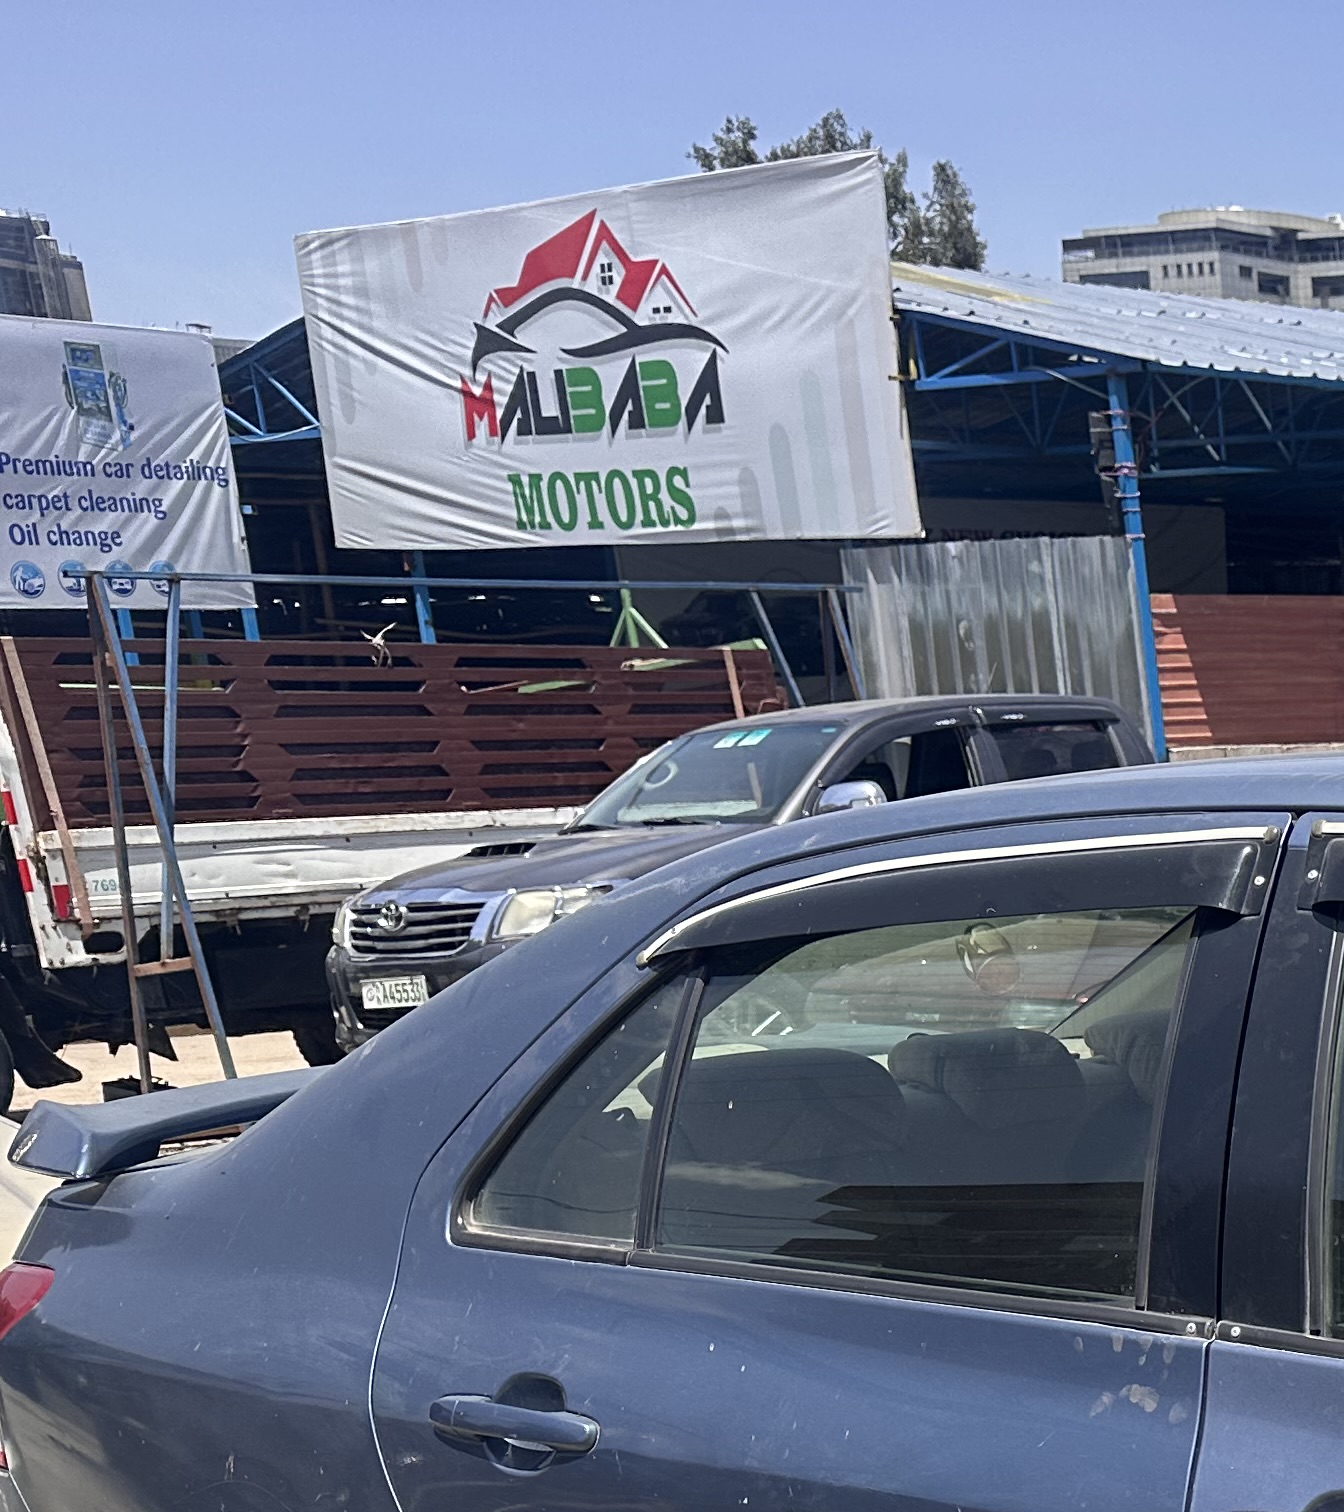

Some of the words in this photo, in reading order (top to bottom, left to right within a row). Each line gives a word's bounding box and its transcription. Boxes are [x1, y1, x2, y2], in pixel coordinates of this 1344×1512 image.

[0, 452, 96, 478] Premium
[102, 460, 134, 480] car
[140, 457, 230, 488] detailing
[3, 491, 72, 517] carpet
[78, 489, 168, 520] cleaning
[507, 466, 697, 532] MOTORS
[8, 522, 40, 546] Oil
[46, 523, 123, 553] change
